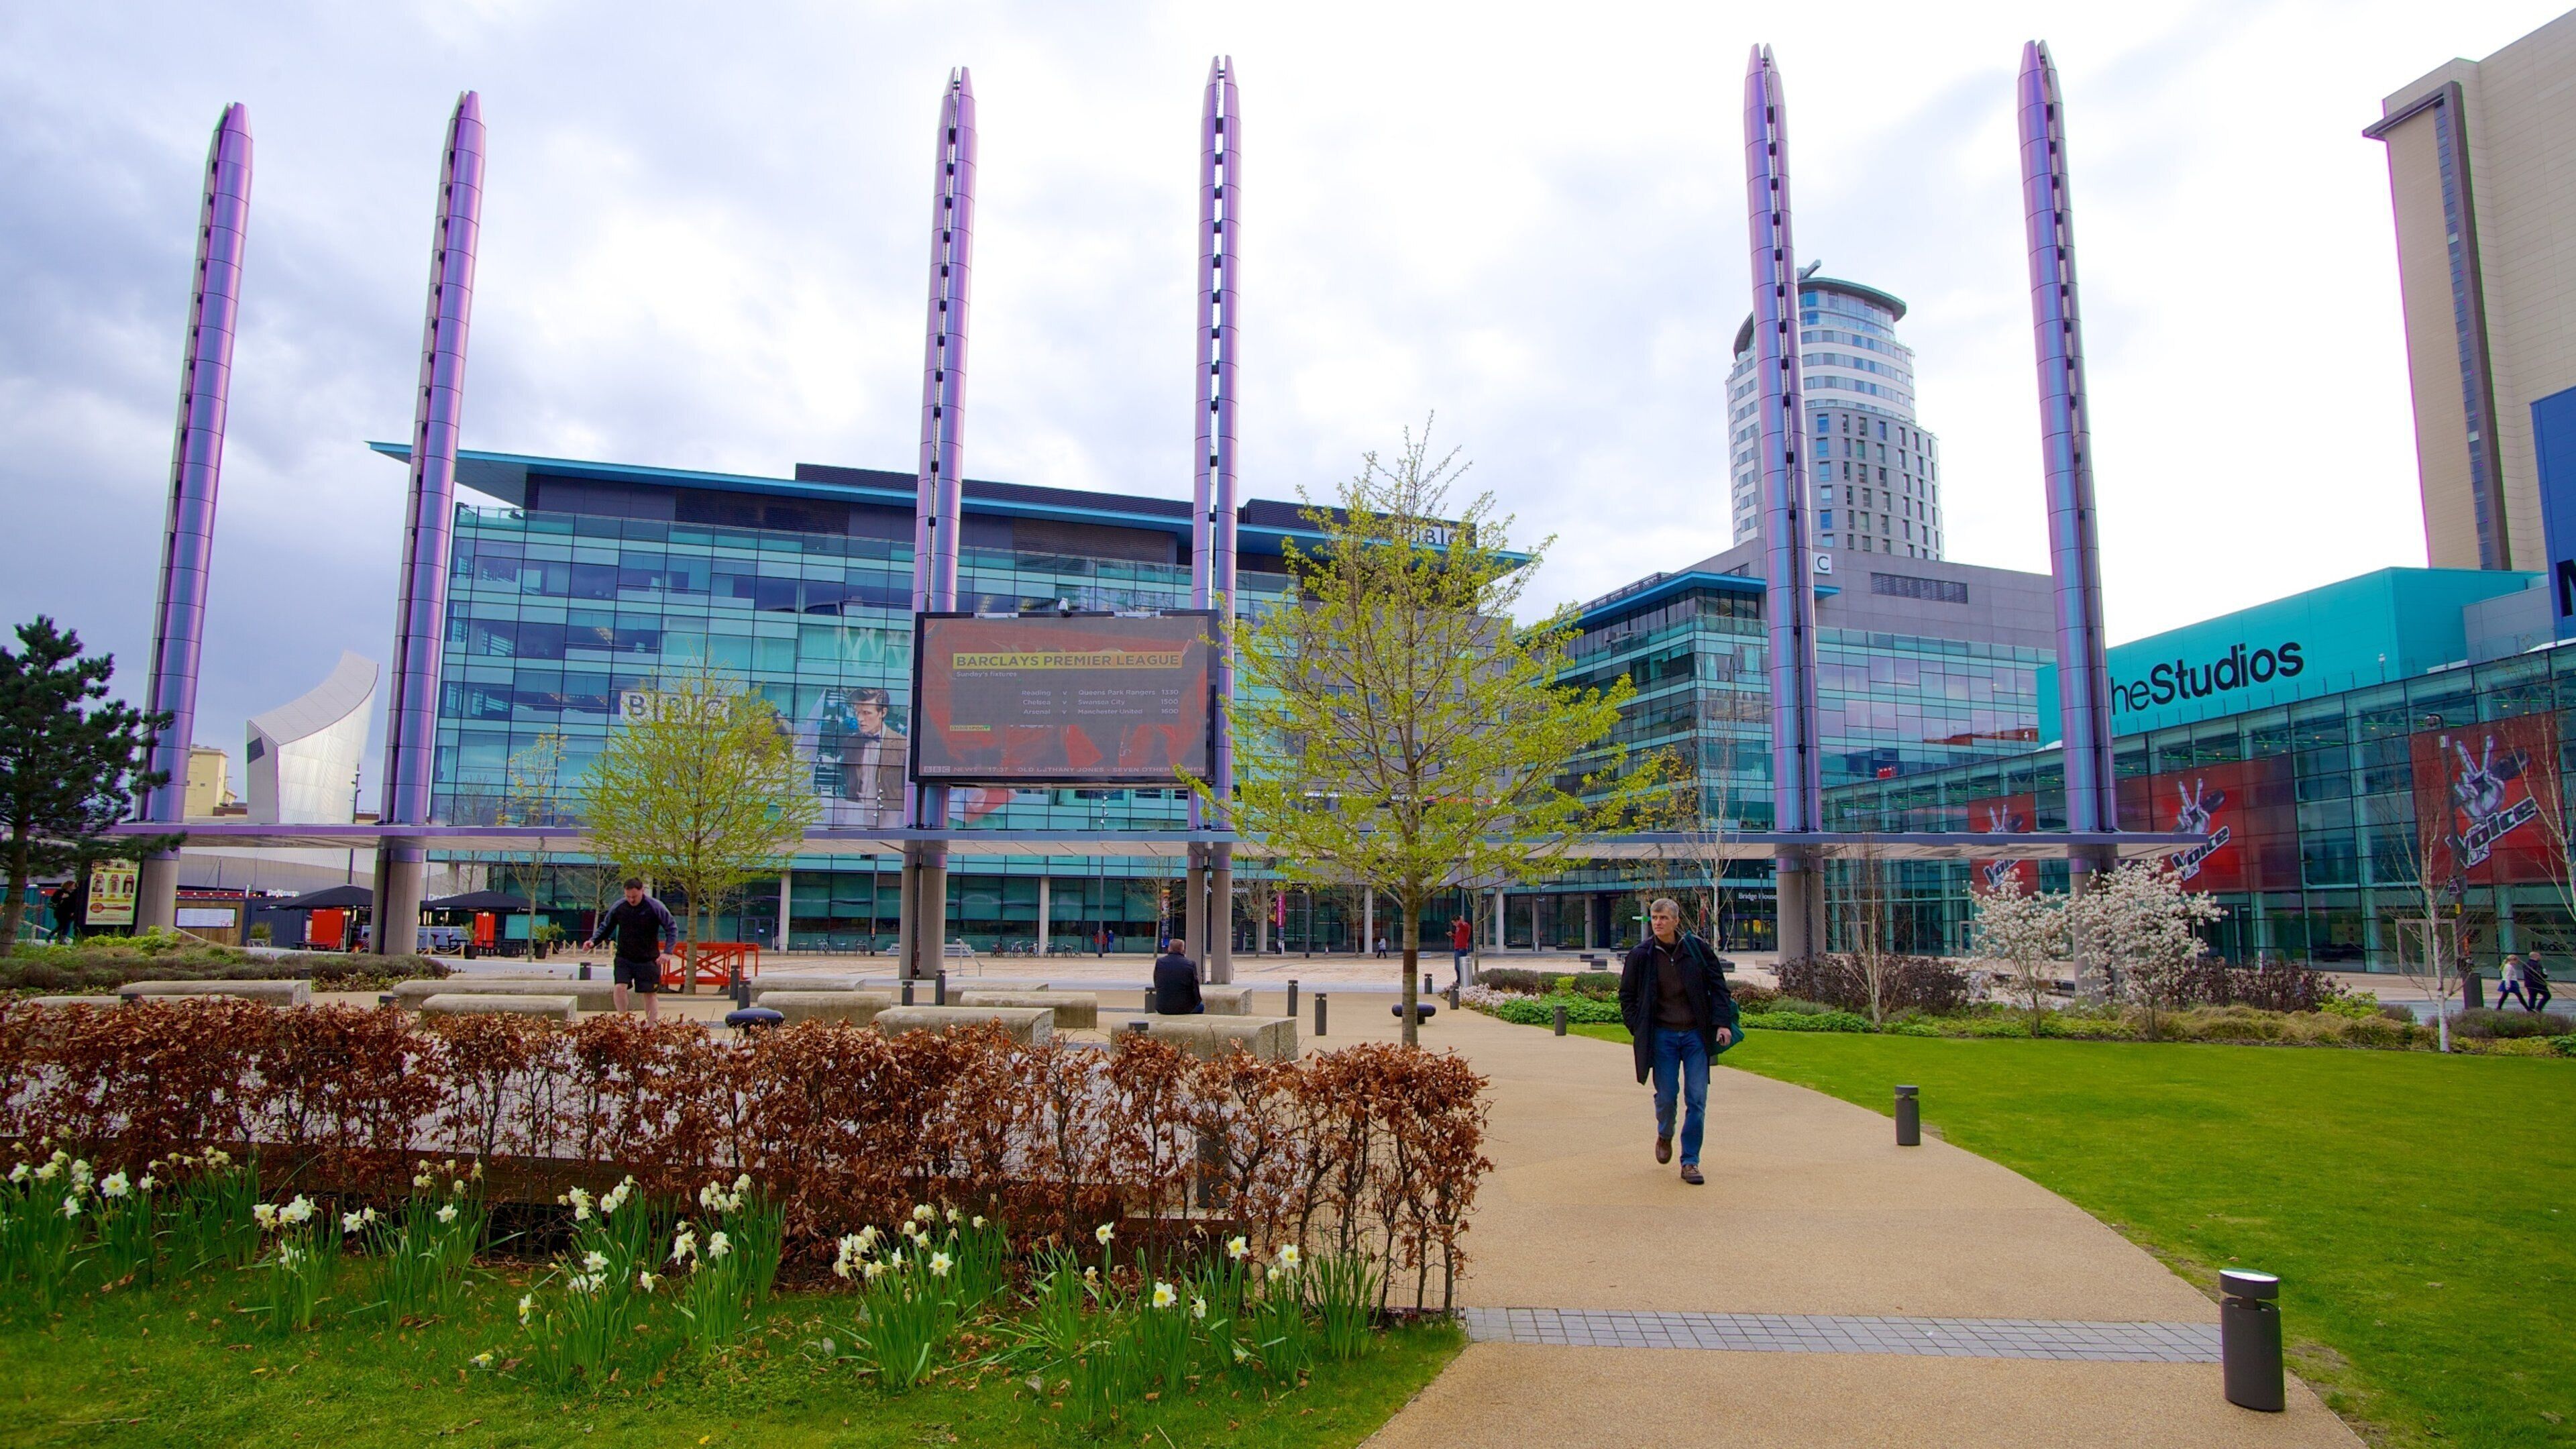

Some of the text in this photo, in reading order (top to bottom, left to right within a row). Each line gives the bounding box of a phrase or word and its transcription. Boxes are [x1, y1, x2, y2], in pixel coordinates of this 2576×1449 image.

[957, 655, 1179, 666] BARCLAYS PREMIER LEAGUE
[2110, 642, 2304, 715] heStudios
[1738, 892, 1758, 901] Bridge
